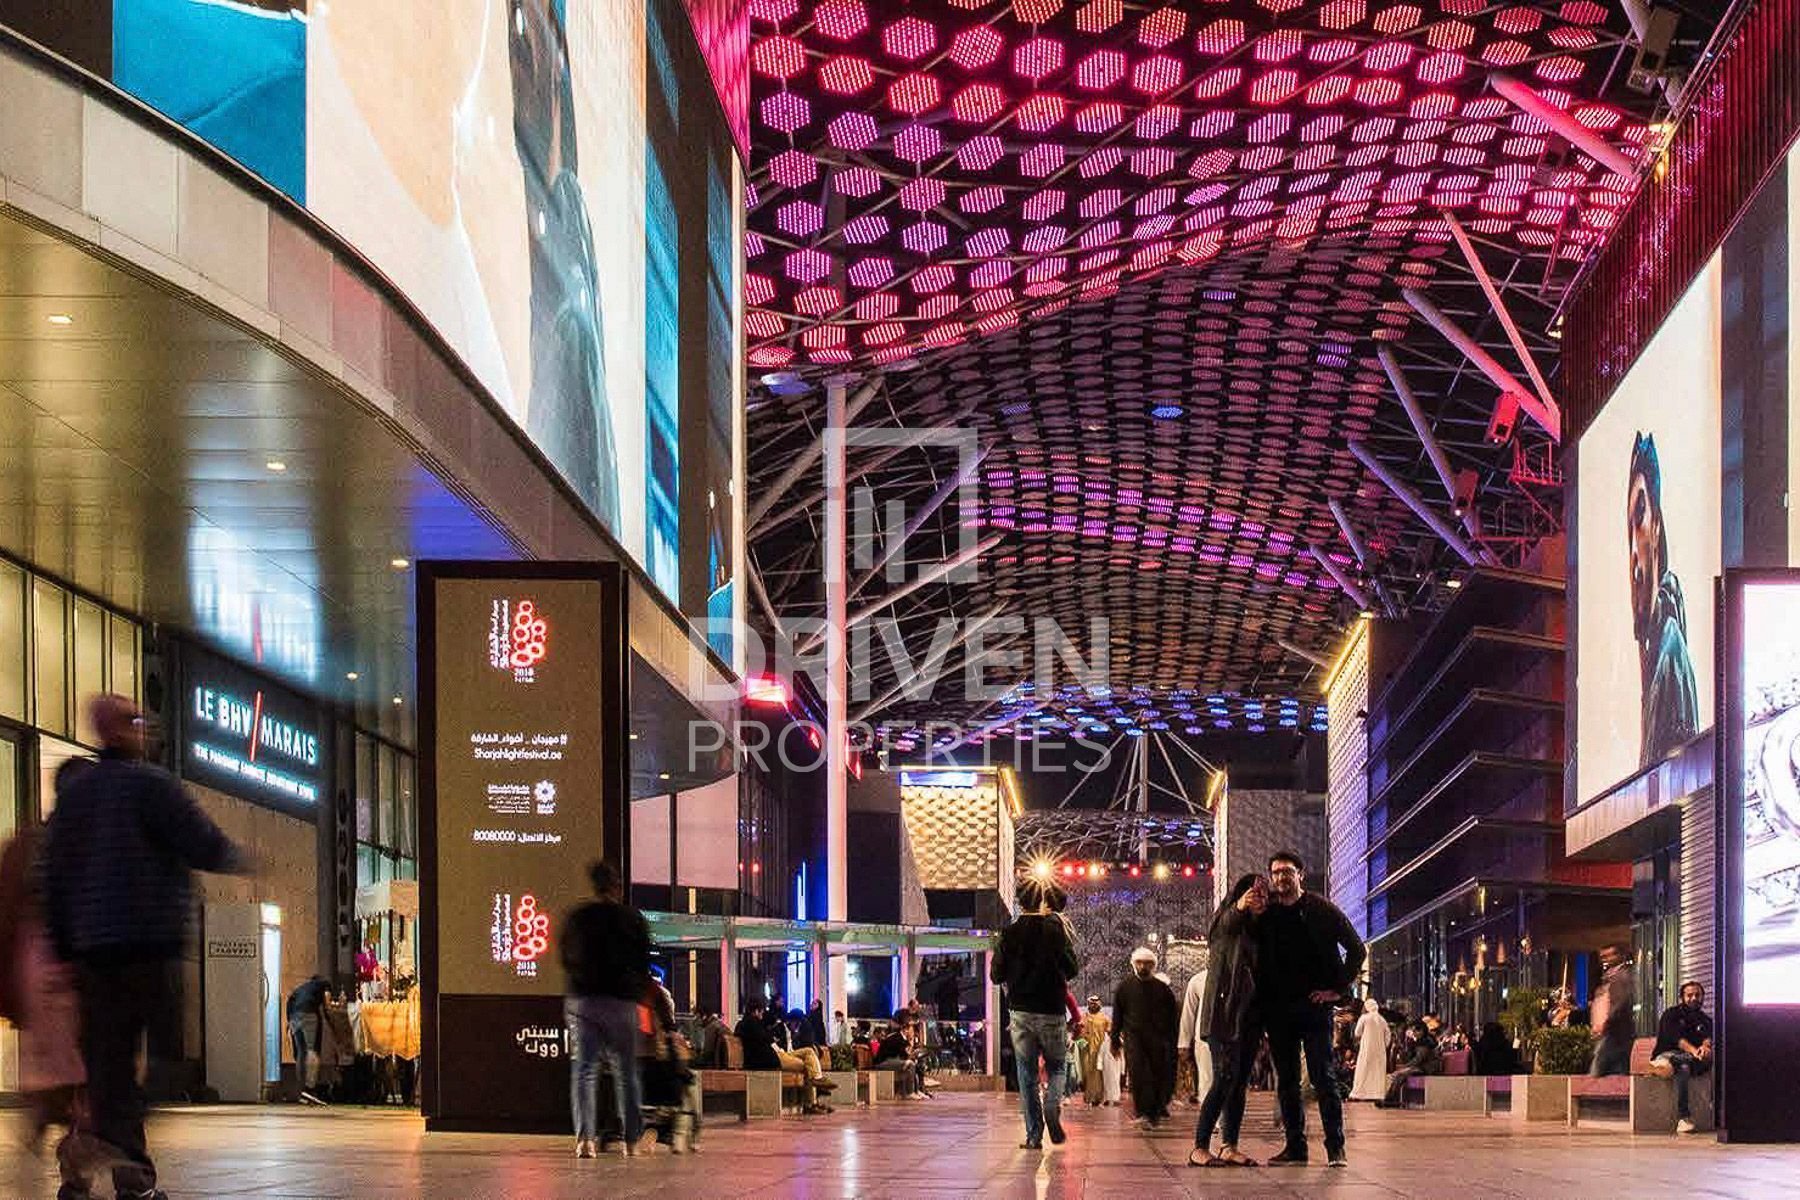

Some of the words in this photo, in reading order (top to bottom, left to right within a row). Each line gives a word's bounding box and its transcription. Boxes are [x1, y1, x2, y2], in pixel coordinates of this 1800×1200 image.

[195, 686, 214, 721] LE
[261, 715, 317, 766] MARAIS
[516, 1024, 559, 1046] سيتي
